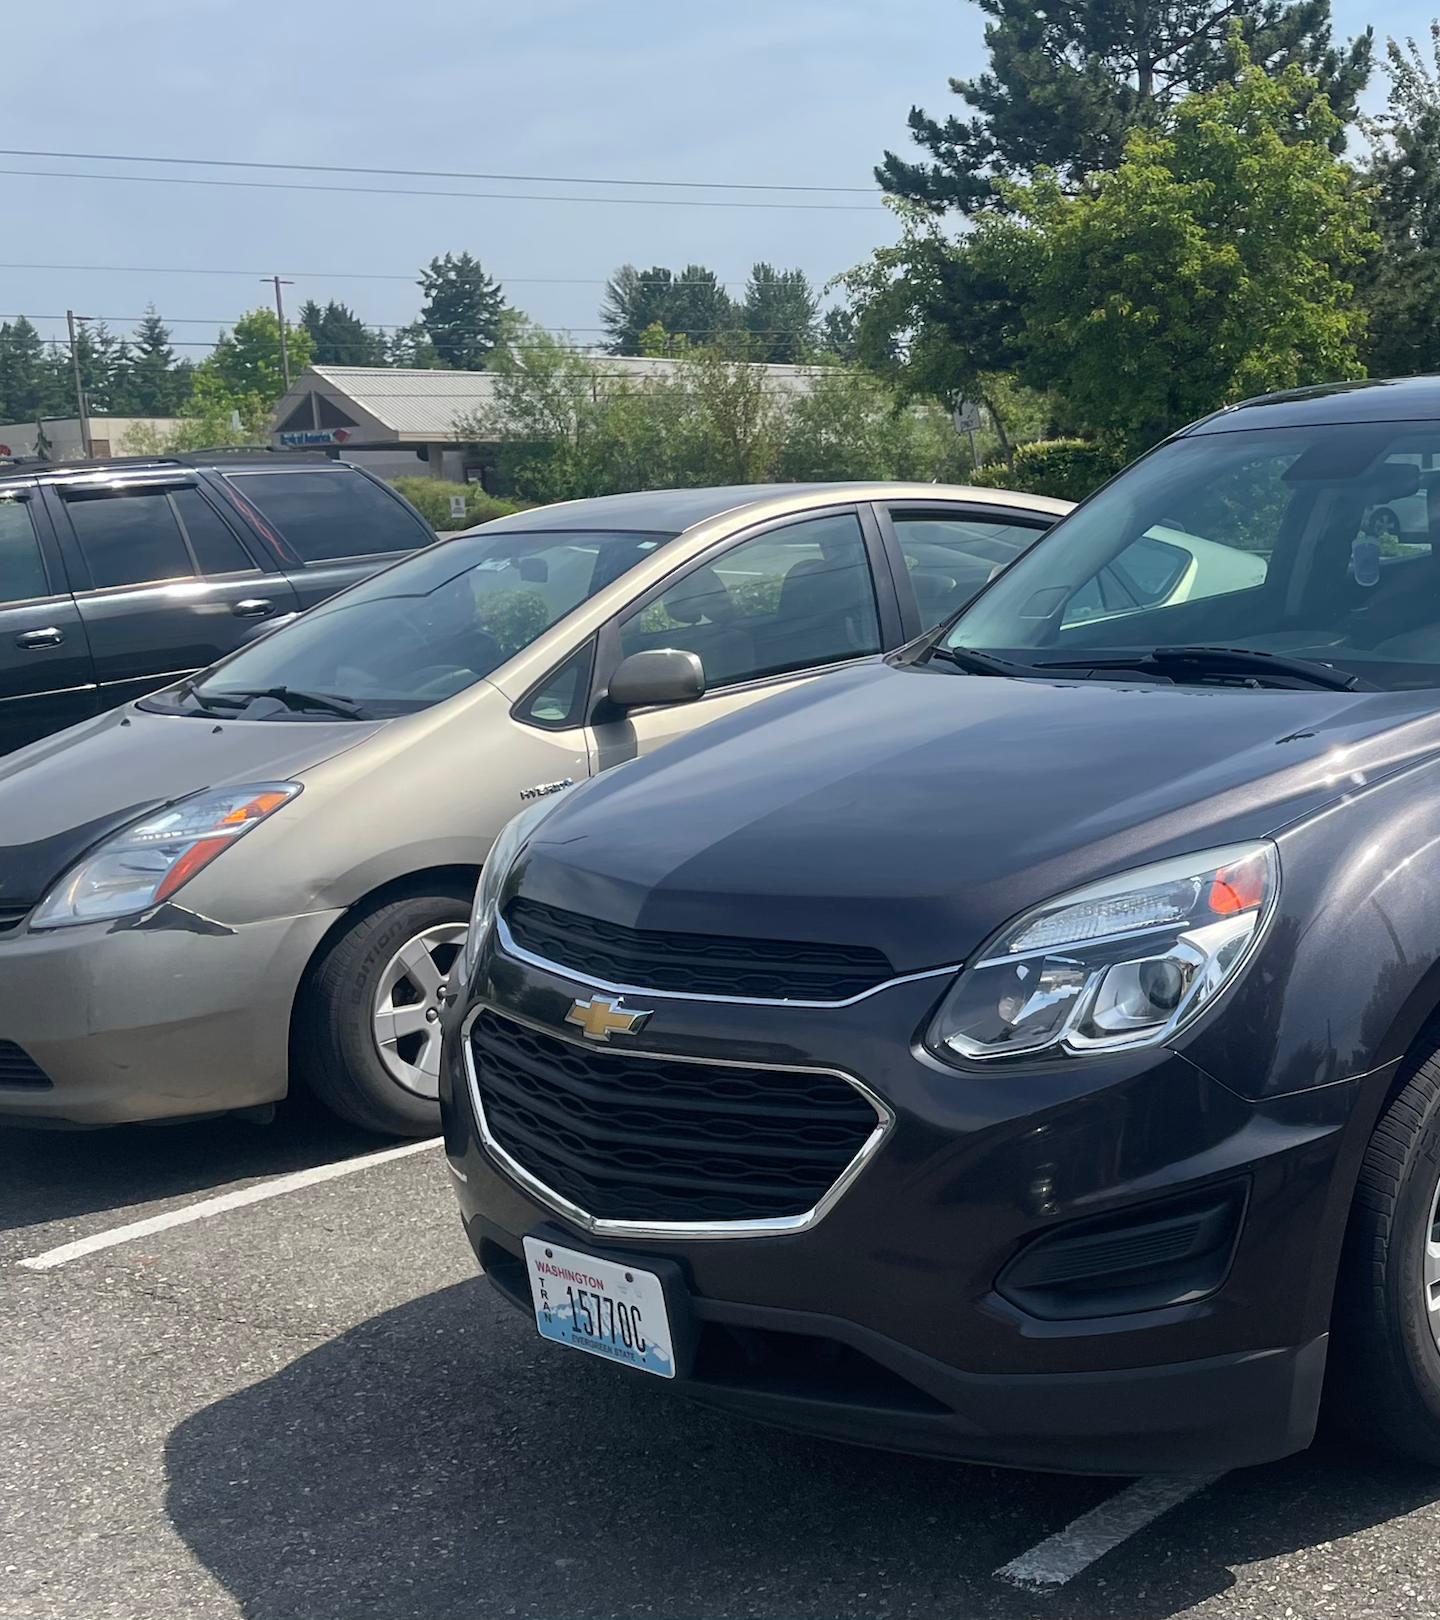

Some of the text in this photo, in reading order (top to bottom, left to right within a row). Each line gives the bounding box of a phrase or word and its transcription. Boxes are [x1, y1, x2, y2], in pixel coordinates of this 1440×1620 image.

[535, 1260, 604, 1291] WASHINGTON
[572, 1335, 635, 1362] EVERGREEN STATE
